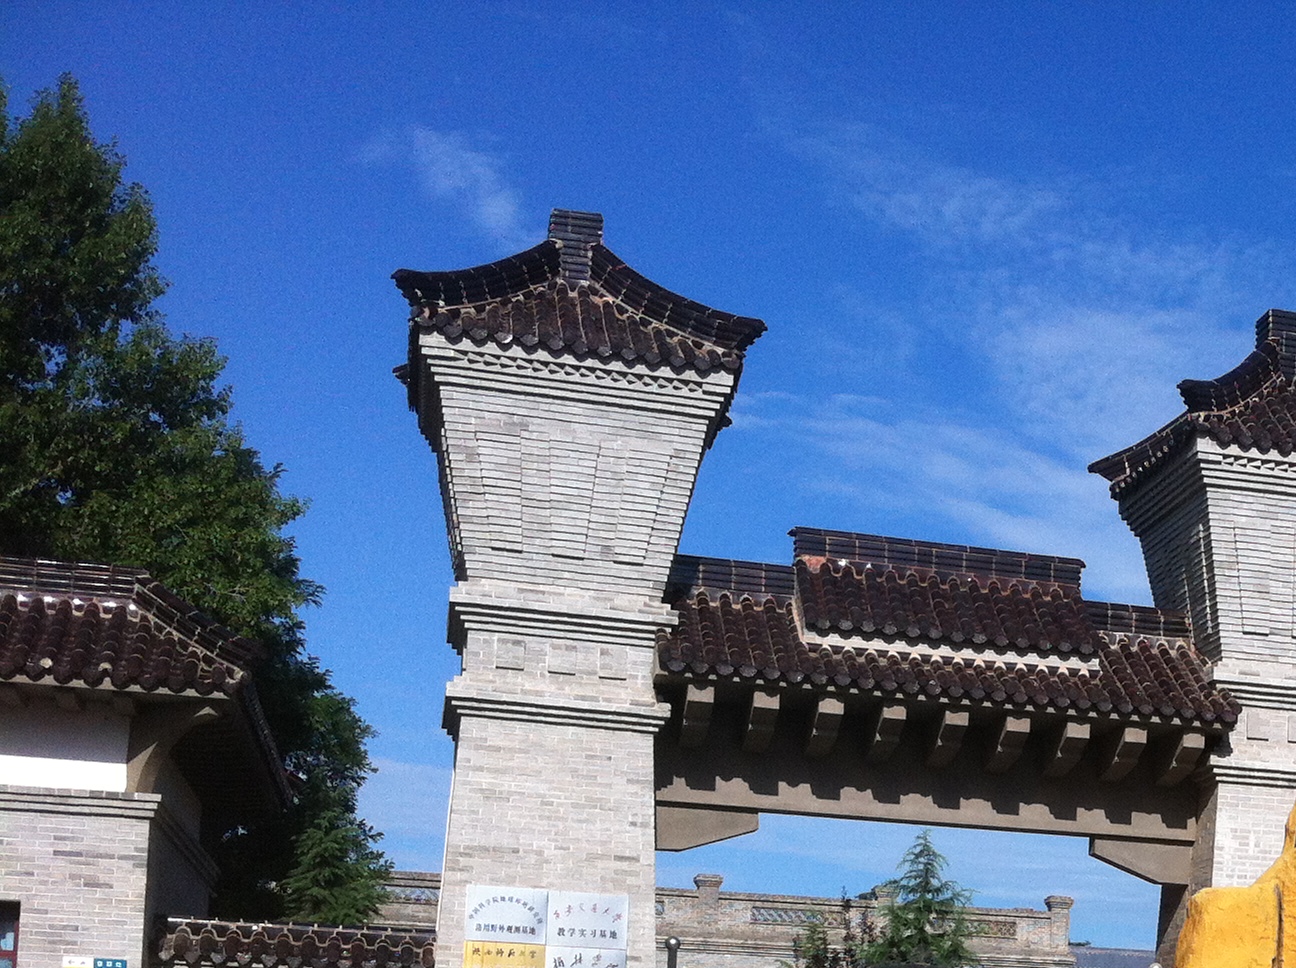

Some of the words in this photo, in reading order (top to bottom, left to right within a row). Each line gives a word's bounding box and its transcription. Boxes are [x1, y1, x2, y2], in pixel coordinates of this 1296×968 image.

[557, 927, 618, 939] 教学实习基地
